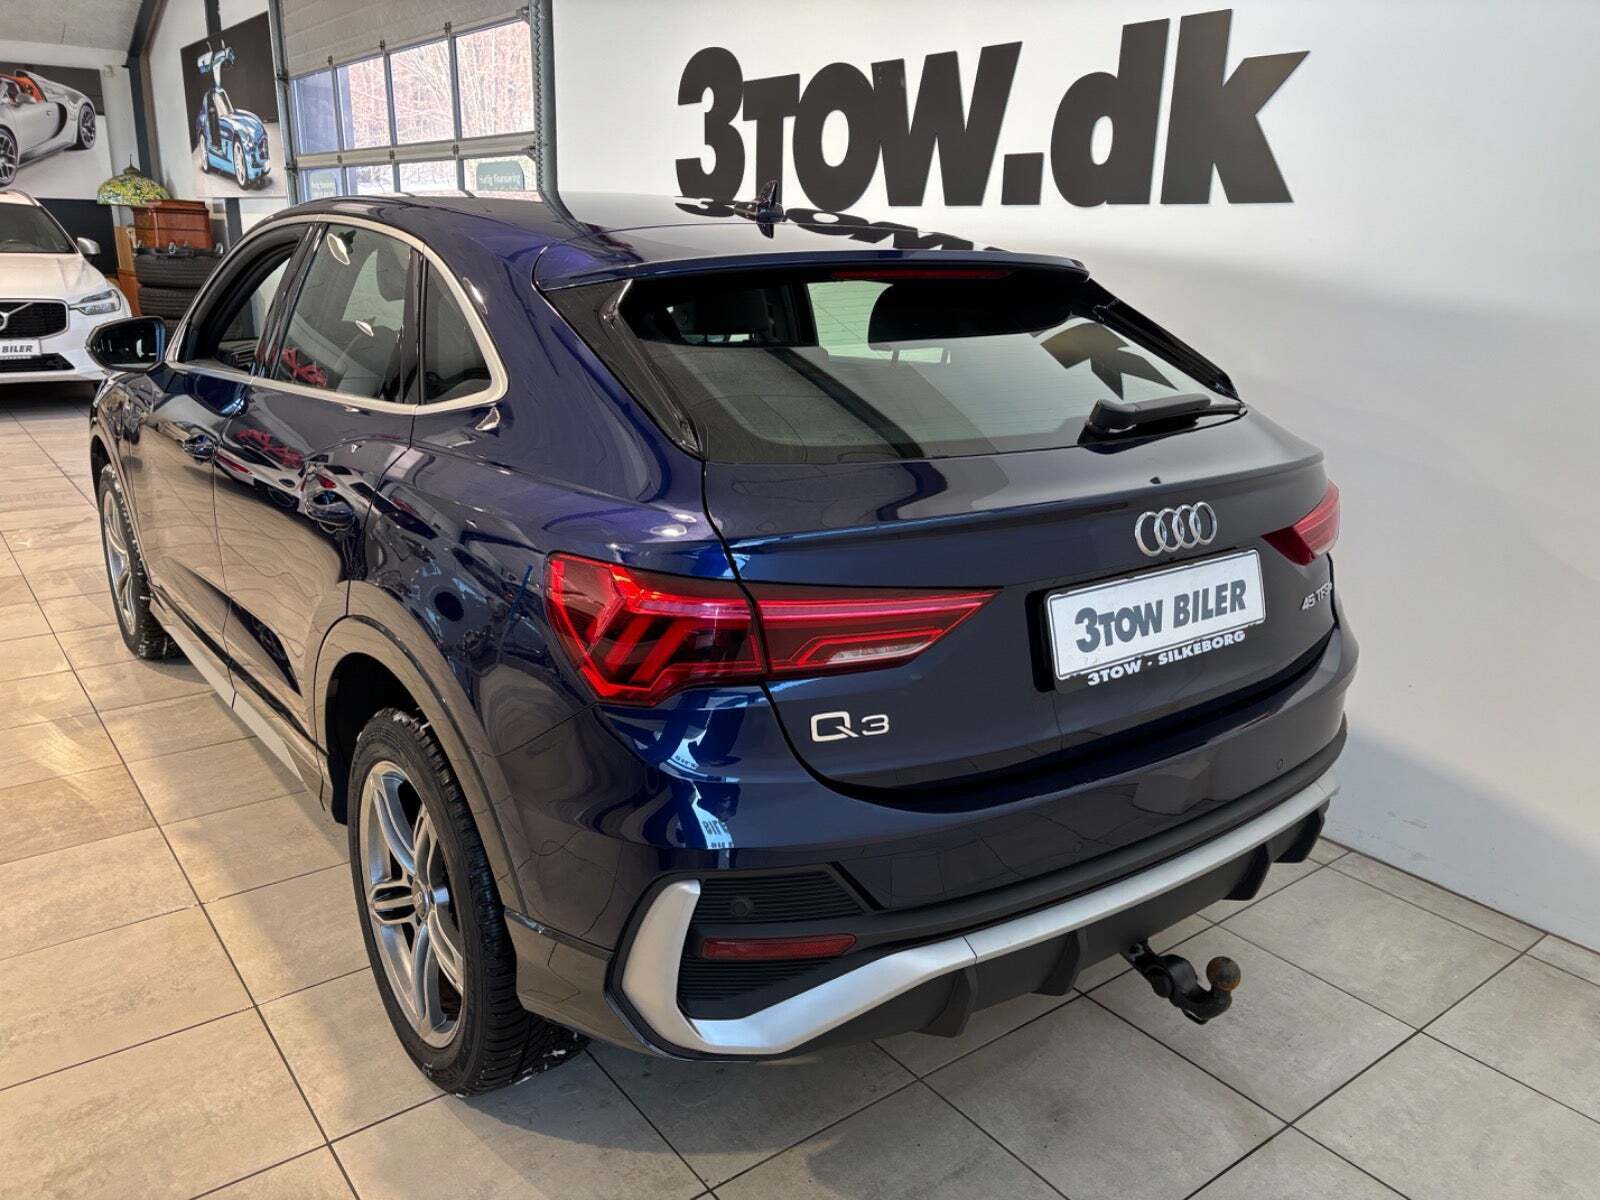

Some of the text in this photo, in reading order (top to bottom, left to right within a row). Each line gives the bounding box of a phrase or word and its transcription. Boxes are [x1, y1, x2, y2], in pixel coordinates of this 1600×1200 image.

[675, 9, 1310, 212] 3TOW.dk
[2, 345, 33, 353] BILER
[1075, 579, 1246, 653] 3TOW BILER
[1302, 593, 1316, 610] 45
[1087, 659, 1142, 686] 3TOW
[1158, 630, 1246, 665] SILKEBORG
[810, 710, 889, 742] Q3
